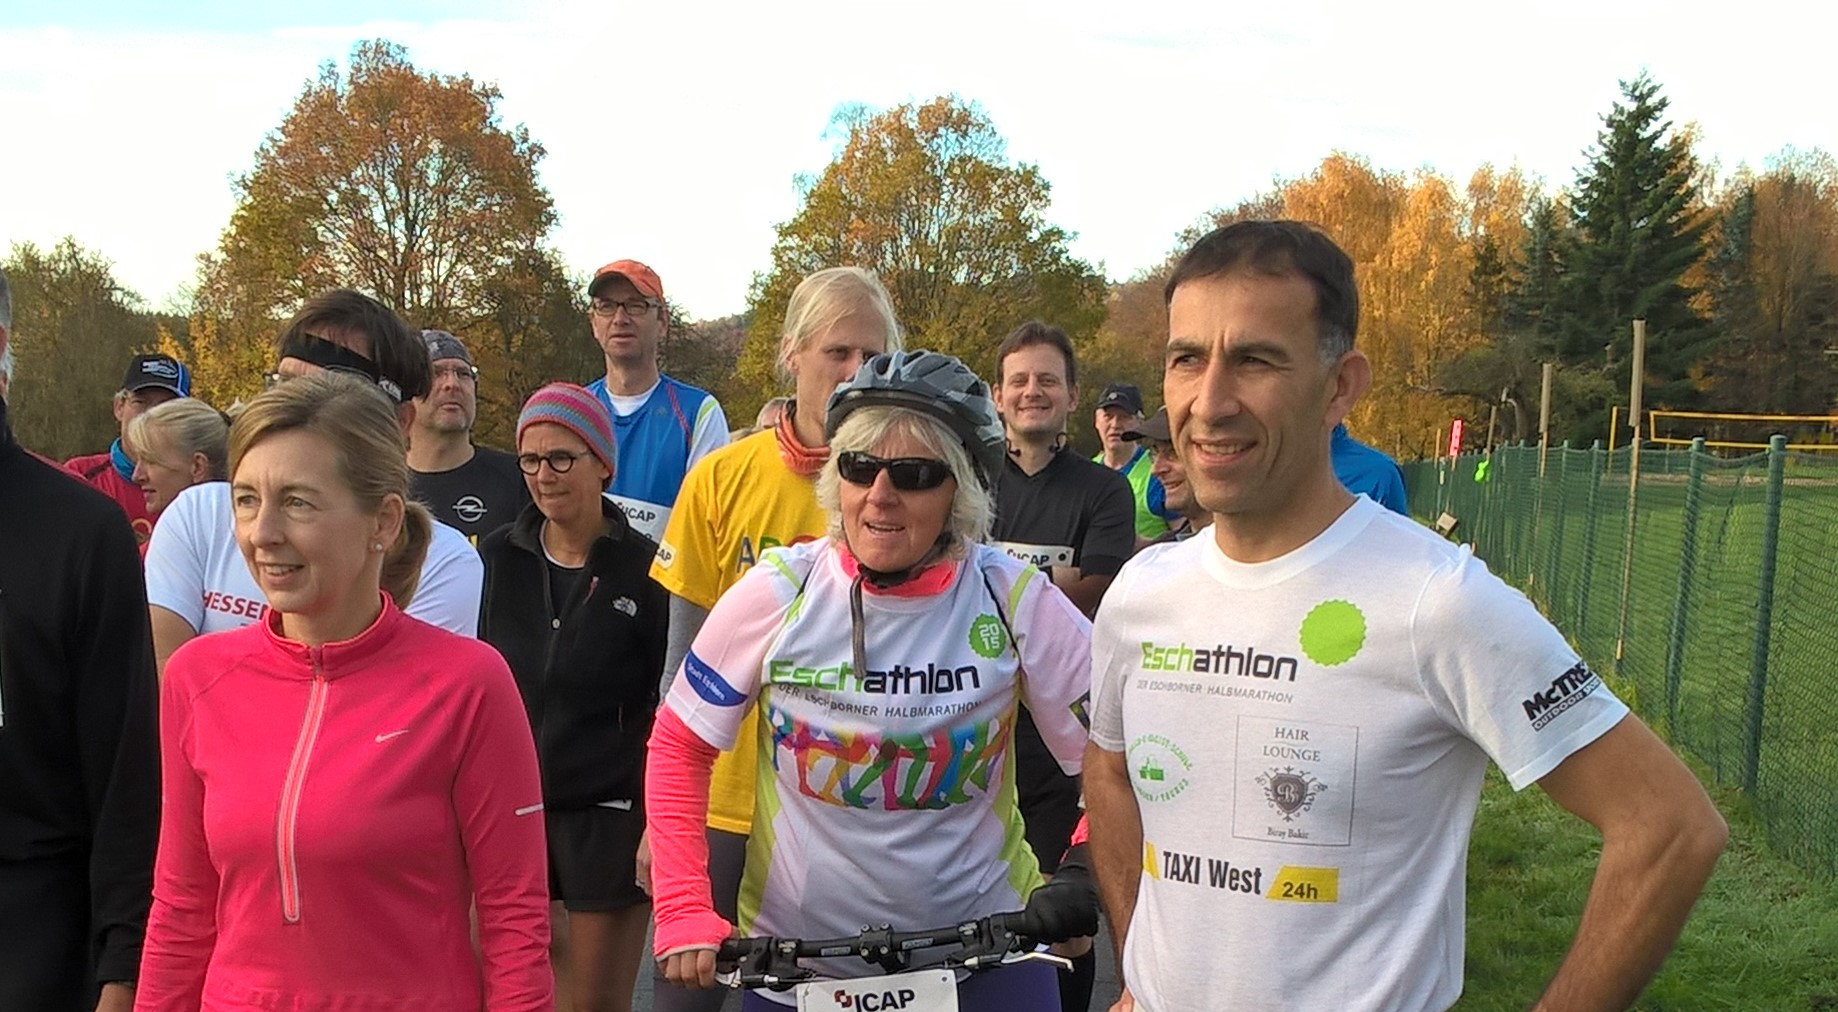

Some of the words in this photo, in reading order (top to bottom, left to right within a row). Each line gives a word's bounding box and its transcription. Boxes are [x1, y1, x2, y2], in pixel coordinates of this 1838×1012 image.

[979, 623, 999, 636] 20
[984, 637, 1000, 649] 15
[1141, 642, 1298, 682] Eschathlon
[769, 660, 981, 695] Eschathlon
[1207, 684, 1294, 704] HALBMARATHON
[1274, 727, 1310, 741] HAIR
[1263, 745, 1321, 762] LOUNGE
[1163, 850, 1201, 885] TAXI
[1208, 858, 1262, 895] West
[1282, 881, 1318, 900] 24h
